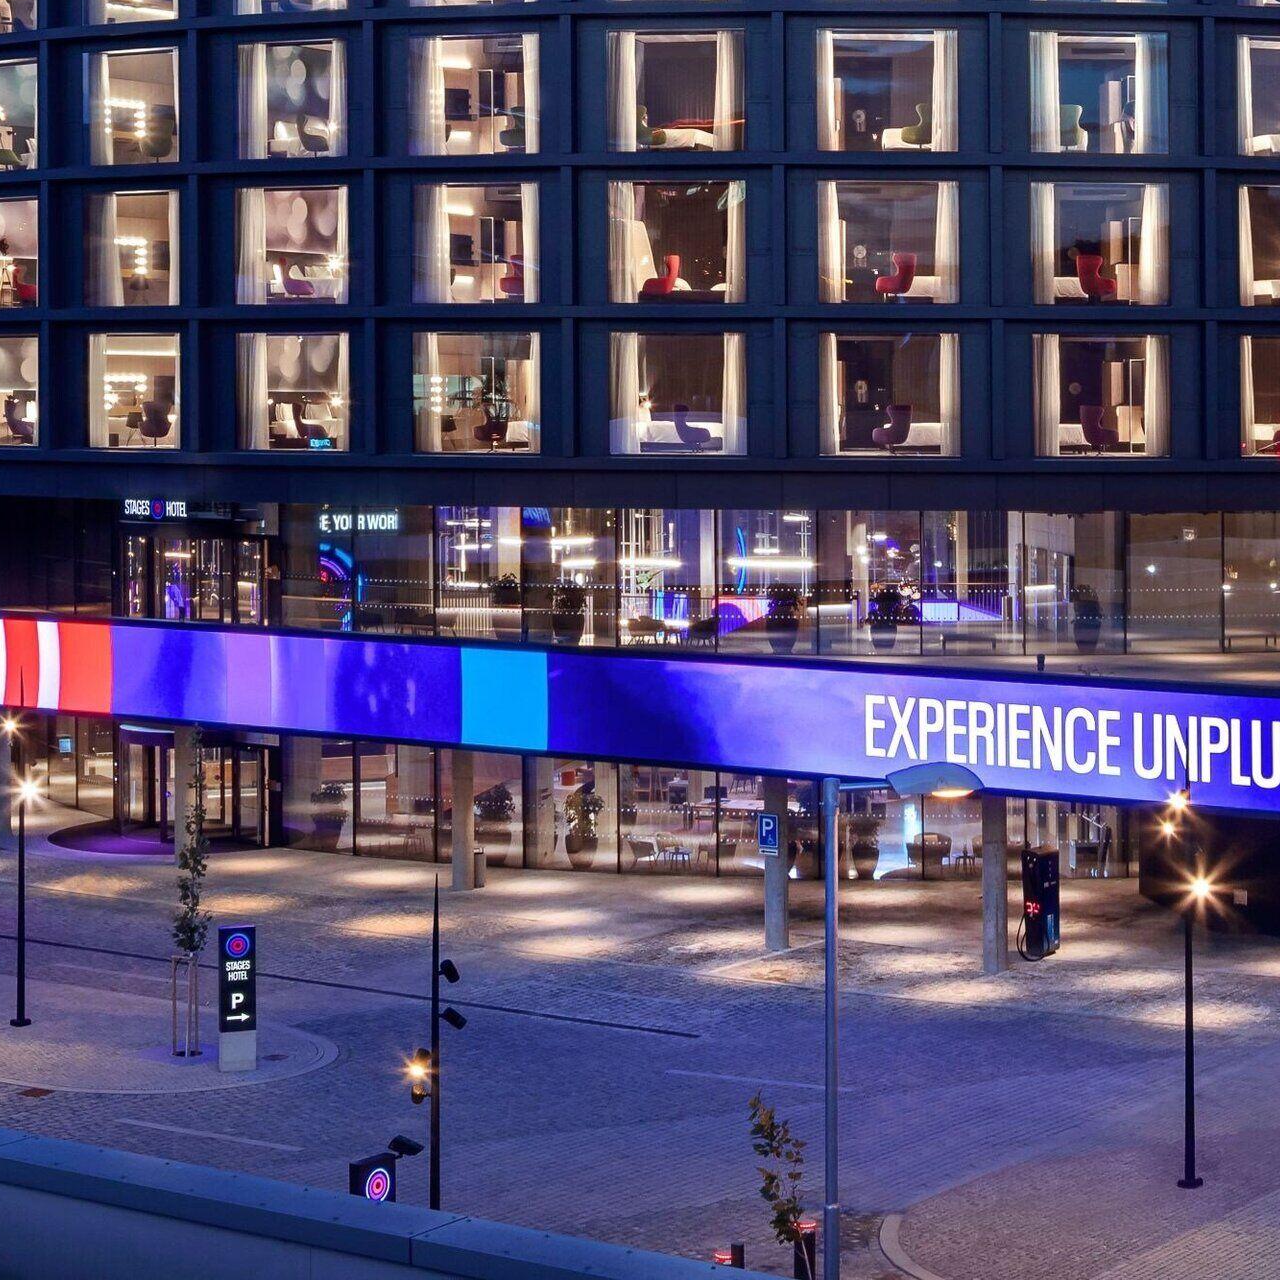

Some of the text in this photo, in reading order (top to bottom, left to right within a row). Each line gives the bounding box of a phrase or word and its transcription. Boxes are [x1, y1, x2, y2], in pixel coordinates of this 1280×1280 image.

[124, 499, 188, 517] STAGES HOTEL
[332, 514, 365, 531] YOR
[864, 694, 1120, 776] EXPERIENCE
[763, 818, 773, 837] P
[226, 960, 250, 971] STAGES
[228, 971, 248, 981] HOTEL
[231, 993, 244, 1009] P
